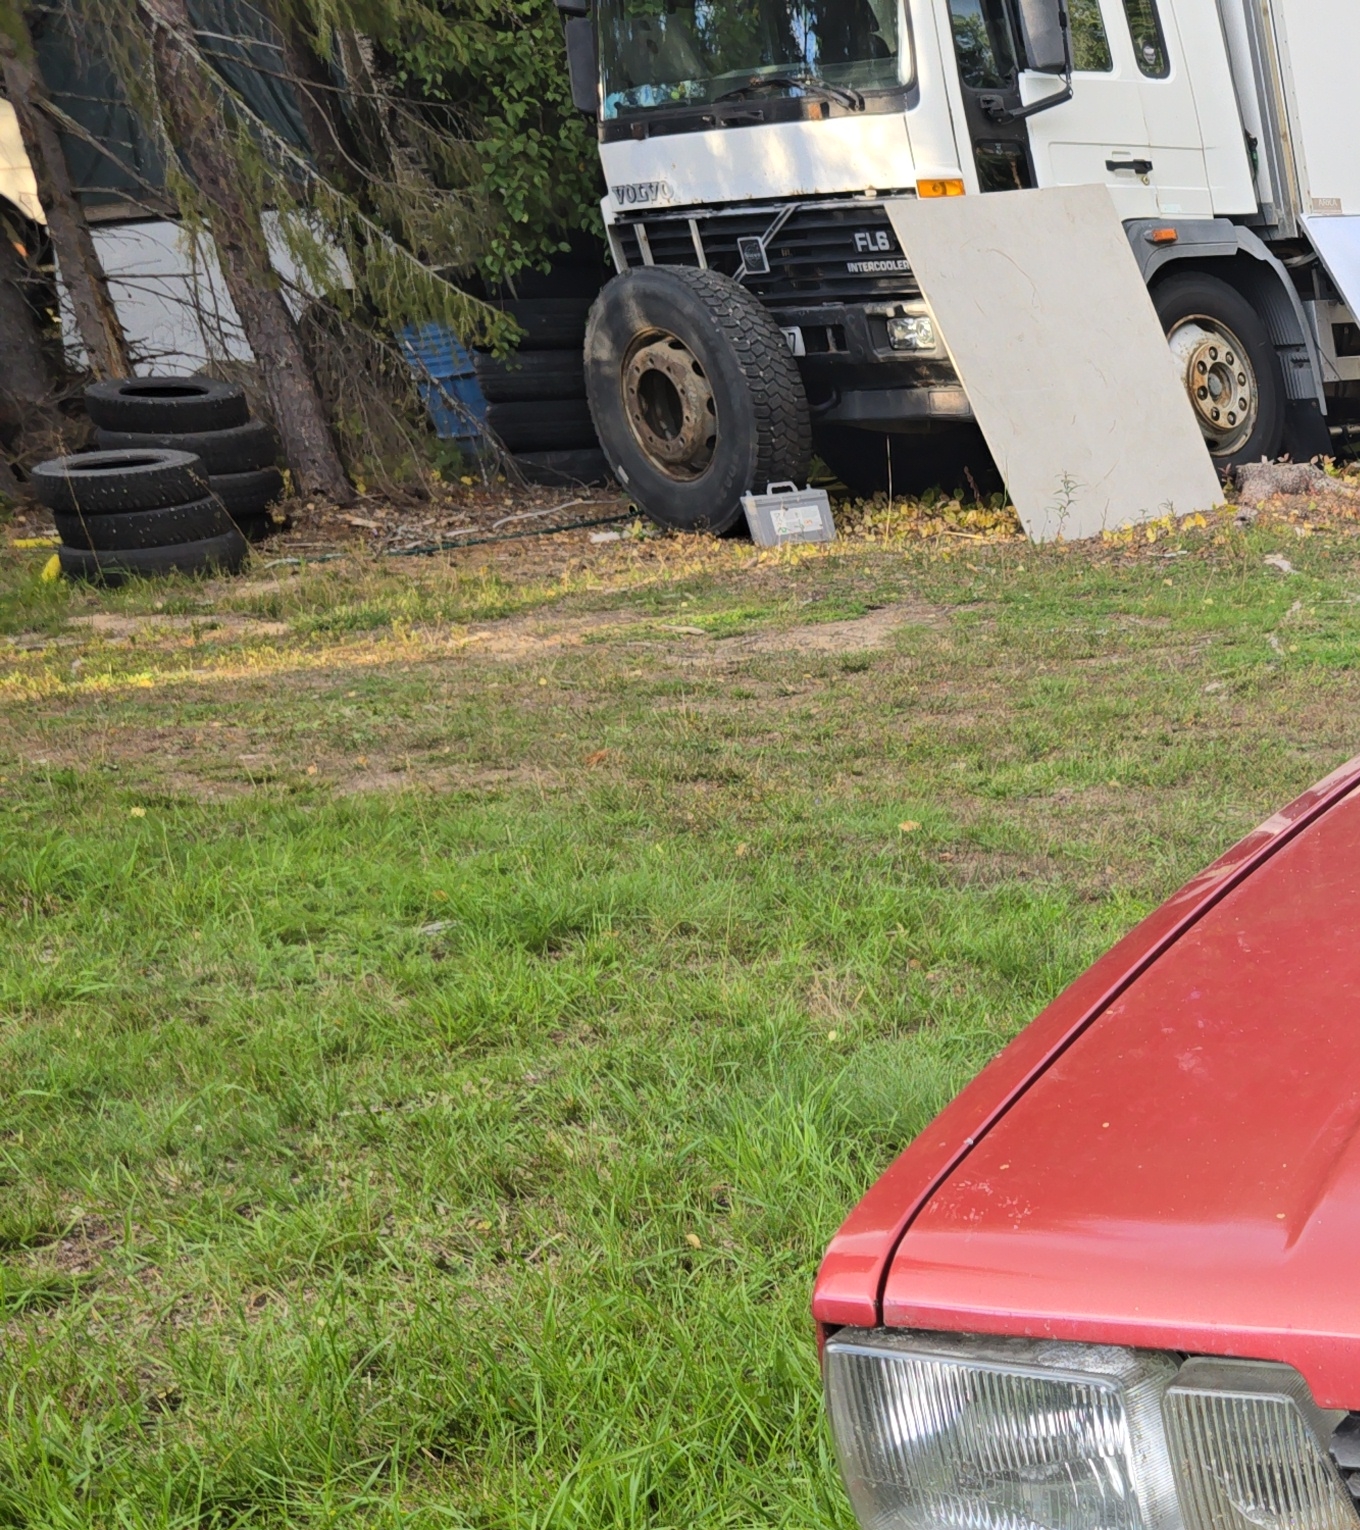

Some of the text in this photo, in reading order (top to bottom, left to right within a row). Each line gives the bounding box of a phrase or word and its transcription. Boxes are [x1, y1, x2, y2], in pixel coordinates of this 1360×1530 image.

[611, 180, 675, 205] VOLVO
[854, 231, 890, 252] FL6
[846, 260, 911, 273] INTERCOOLER
